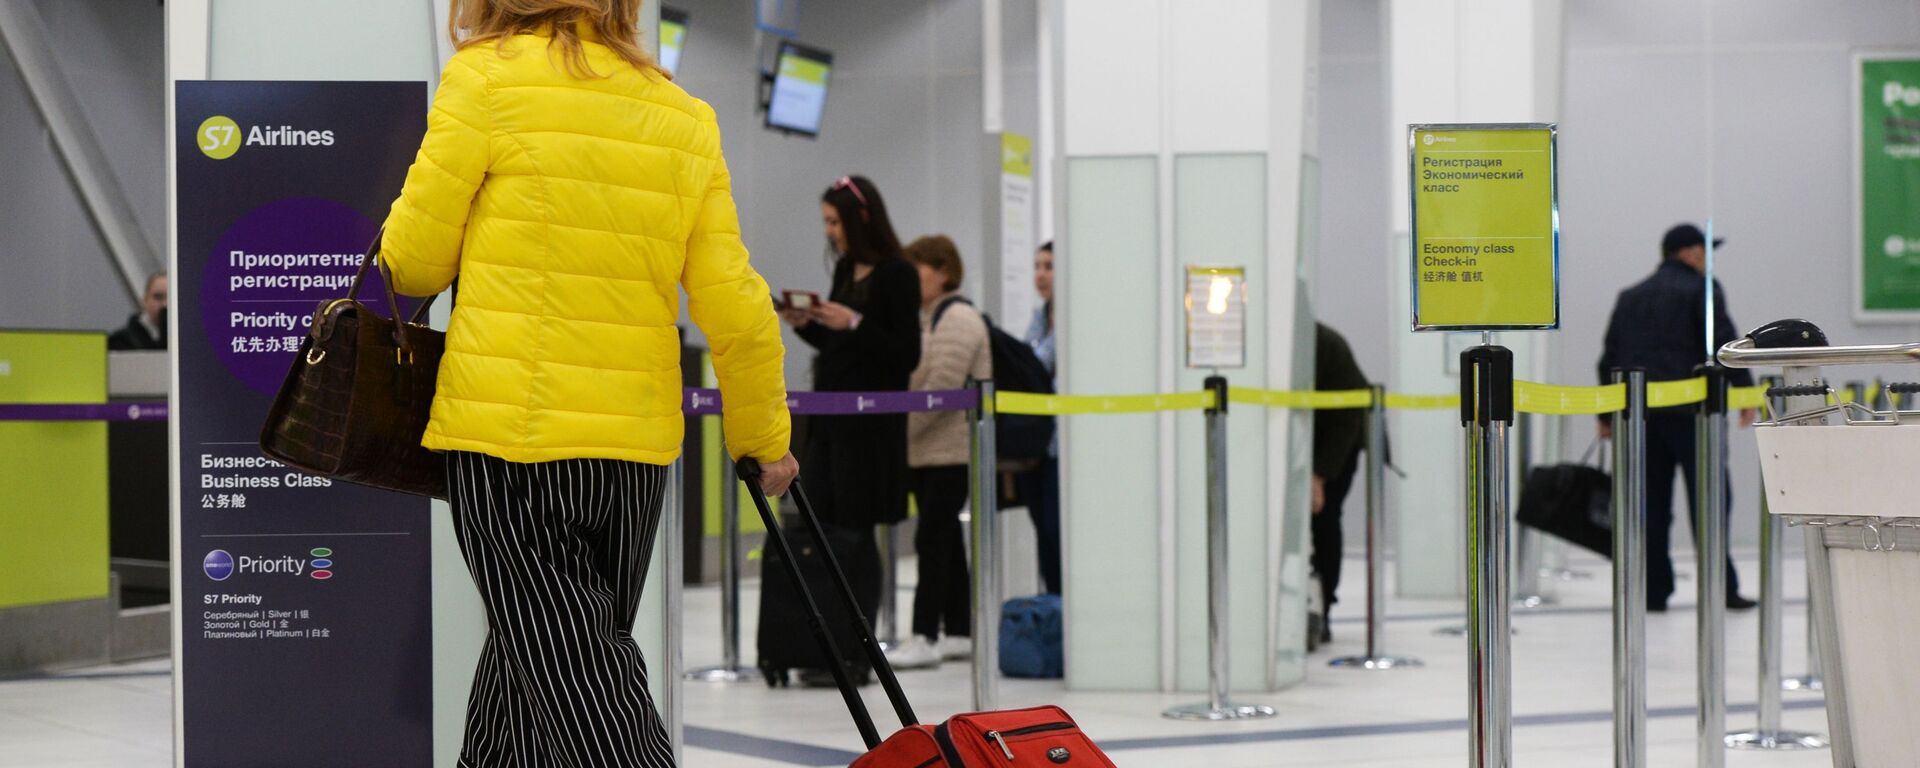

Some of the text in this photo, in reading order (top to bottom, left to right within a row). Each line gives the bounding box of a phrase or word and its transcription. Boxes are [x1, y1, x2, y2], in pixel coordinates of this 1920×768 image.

[204, 125, 334, 150] S7 Airlines
[1423, 157, 1502, 168] Регистрация
[1423, 169, 1523, 180] Экономический
[1423, 184, 1459, 192] класс
[1423, 244, 1515, 255] Economy class
[1423, 256, 1476, 266] Check-in
[1423, 271, 1483, 282] 经济舱 值机
[231, 312, 297, 330] Priority
[231, 336, 306, 352] 优先办理
[201, 454, 286, 468] Бизнес-к
[201, 473, 332, 488] Business Class
[201, 494, 246, 508] 公务舱
[239, 555, 306, 576] Priority
[204, 594, 262, 605] S7 Priority
[203, 610, 260, 620] Серебряный
[268, 610, 292, 618] Silver
[203, 621, 241, 629] Золотой
[249, 620, 270, 628] Gold
[280, 619, 289, 628] 金
[203, 630, 258, 639] Платиновый
[266, 629, 303, 637] Platinum
[312, 628, 330, 637] 白金
